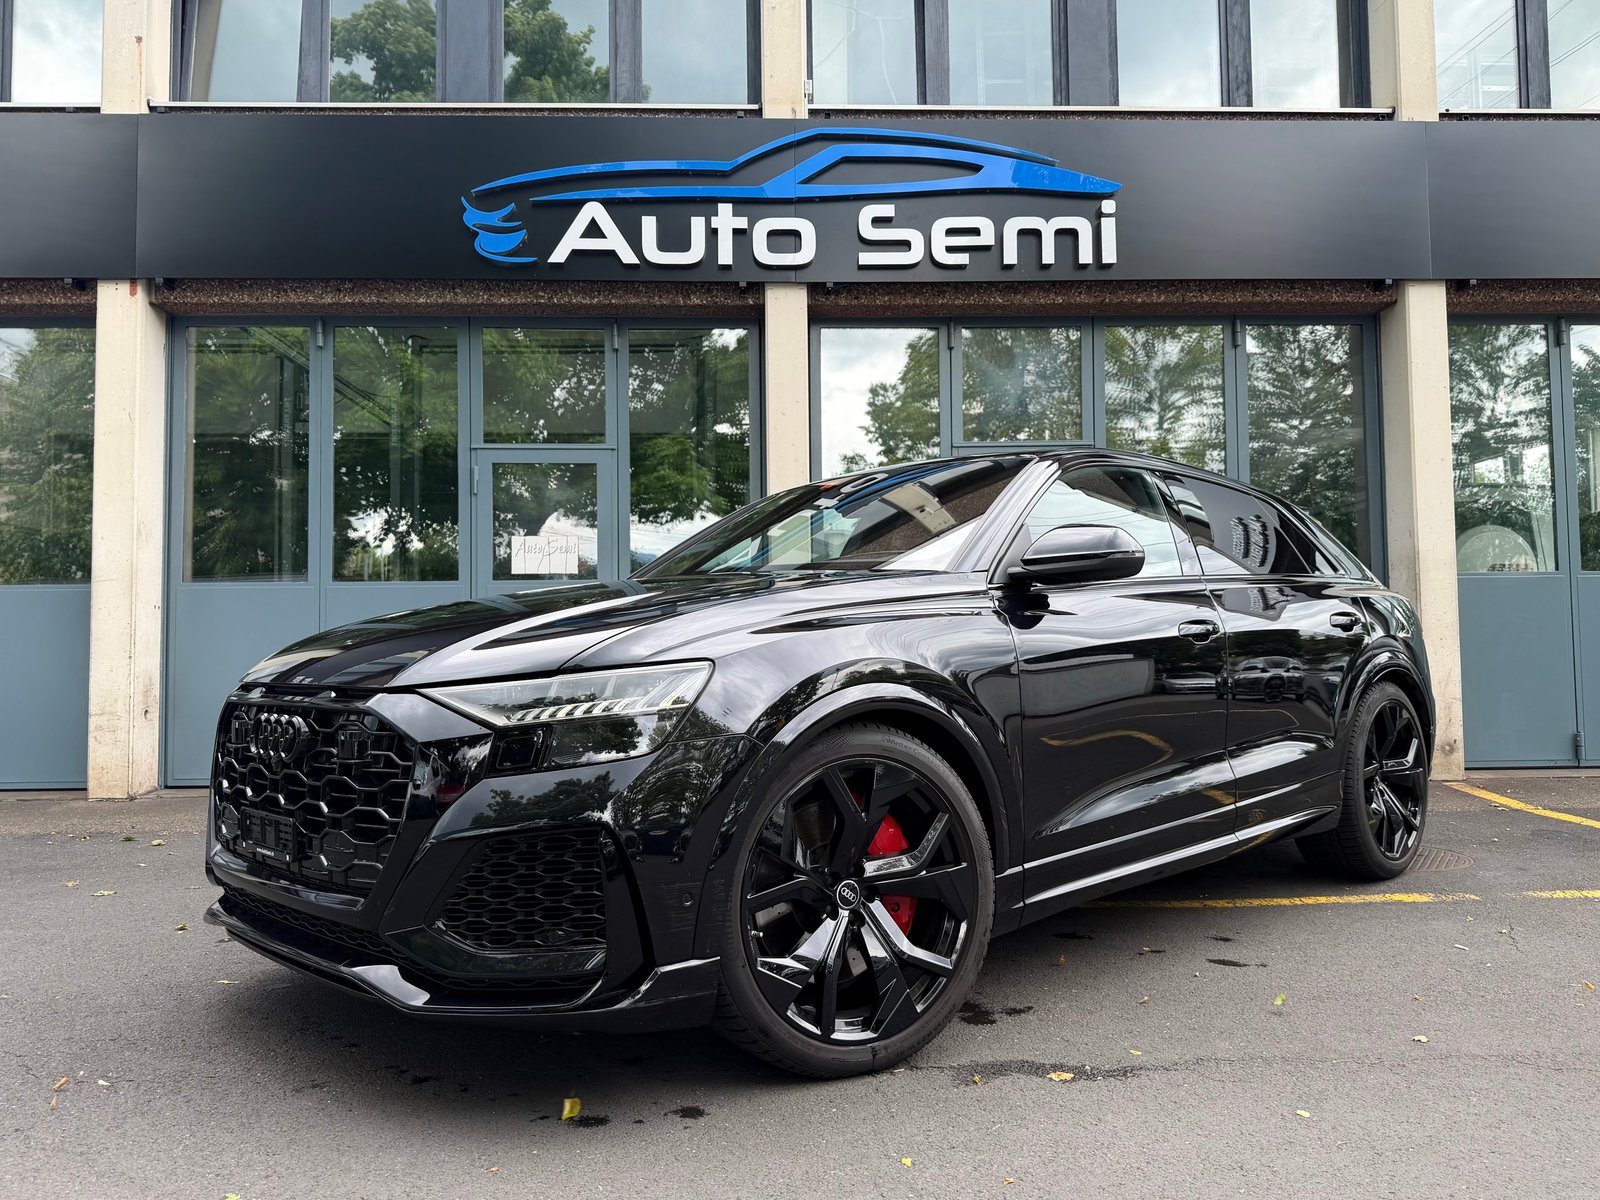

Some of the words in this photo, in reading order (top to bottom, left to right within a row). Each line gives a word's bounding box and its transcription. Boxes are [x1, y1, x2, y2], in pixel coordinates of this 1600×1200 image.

[547, 201, 817, 266] Auto
[857, 199, 1118, 266] Semi
[514, 540, 544, 557] Auto
